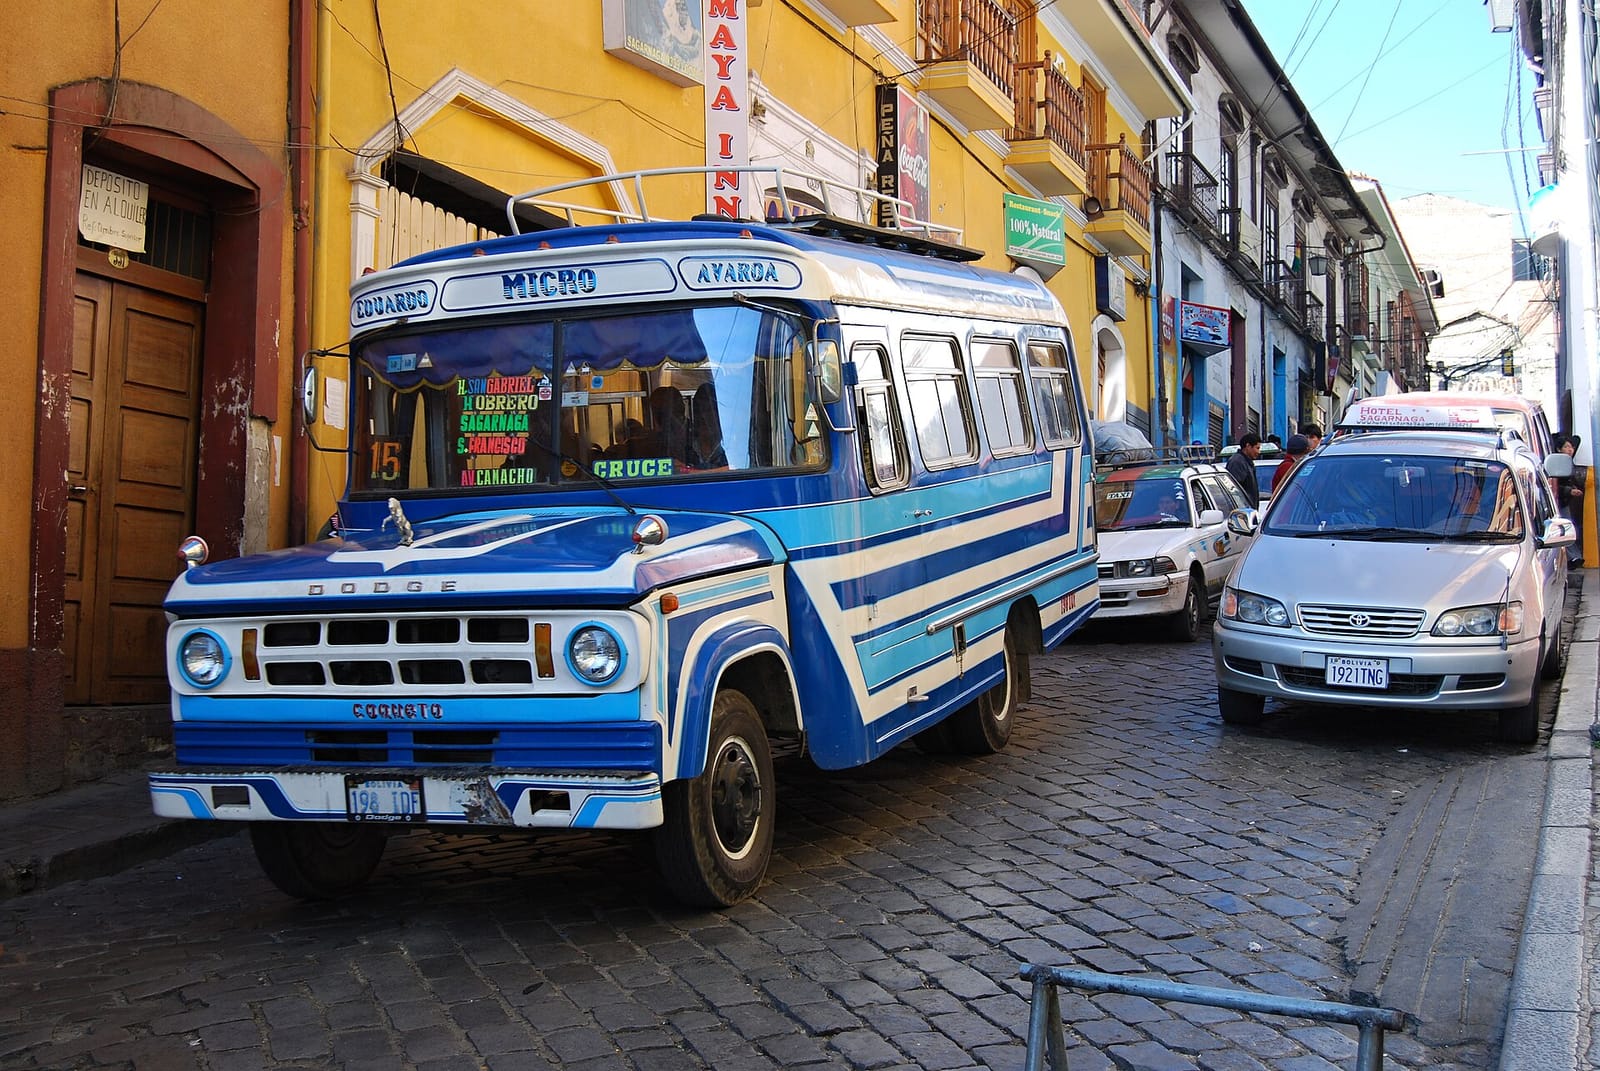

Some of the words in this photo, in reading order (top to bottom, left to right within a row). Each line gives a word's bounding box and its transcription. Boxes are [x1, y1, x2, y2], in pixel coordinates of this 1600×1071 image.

[708, 0, 740, 111] MAYA
[880, 103, 894, 162] PEÑA
[86, 168, 141, 201] DEPOSITO
[712, 133, 742, 218] INN
[83, 190, 99, 210] EN
[1010, 217, 1031, 236] 100%
[1031, 222, 1061, 242] Natural
[502, 268, 596, 300] MICRO
[356, 289, 429, 319] EDUARDO
[486, 376, 534, 394] GABRIEL
[475, 394, 539, 411] OBRERO
[460, 414, 529, 432] SAGARNAGA
[1360, 415, 1426, 423] SAGARNAGA
[468, 436, 527, 454] FRANCISCO
[593, 458, 673, 479] CRUCE
[308, 580, 457, 596] DODGE
[1332, 666, 1384, 686] 1921TNG
[365, 814, 402, 822] Dodge
